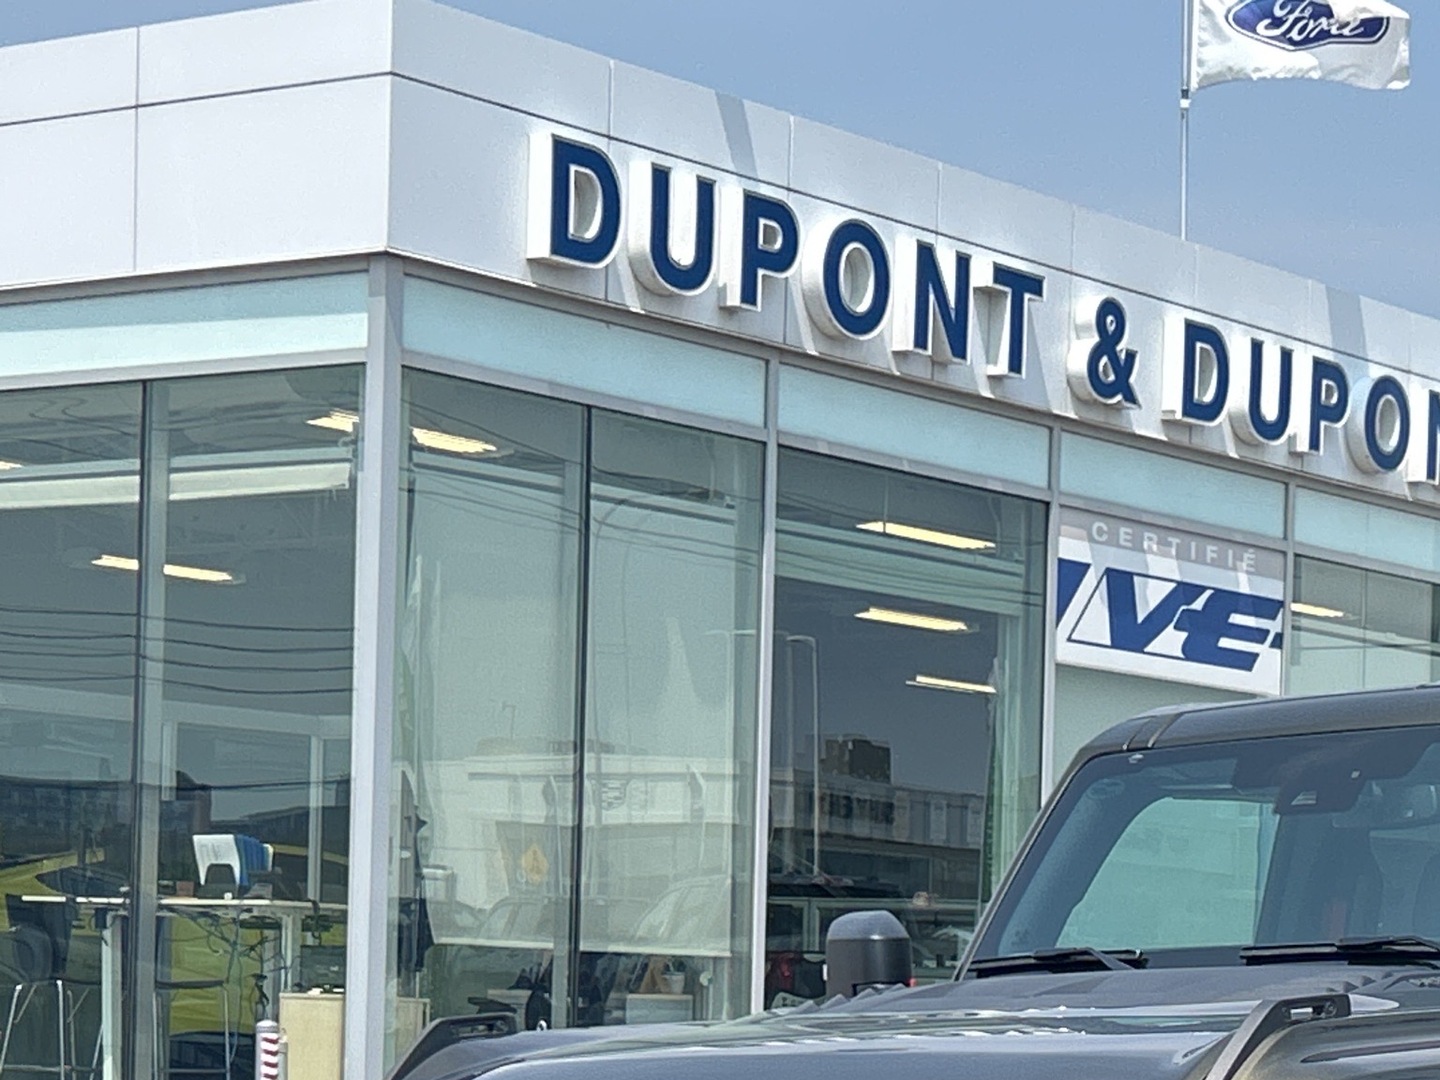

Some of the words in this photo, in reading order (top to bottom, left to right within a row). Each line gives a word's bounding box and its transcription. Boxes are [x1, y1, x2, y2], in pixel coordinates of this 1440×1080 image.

[546, 132, 1046, 378] DUPONT
[1084, 295, 1141, 408] &
[1091, 521, 1257, 573] CERTIFIÉ
